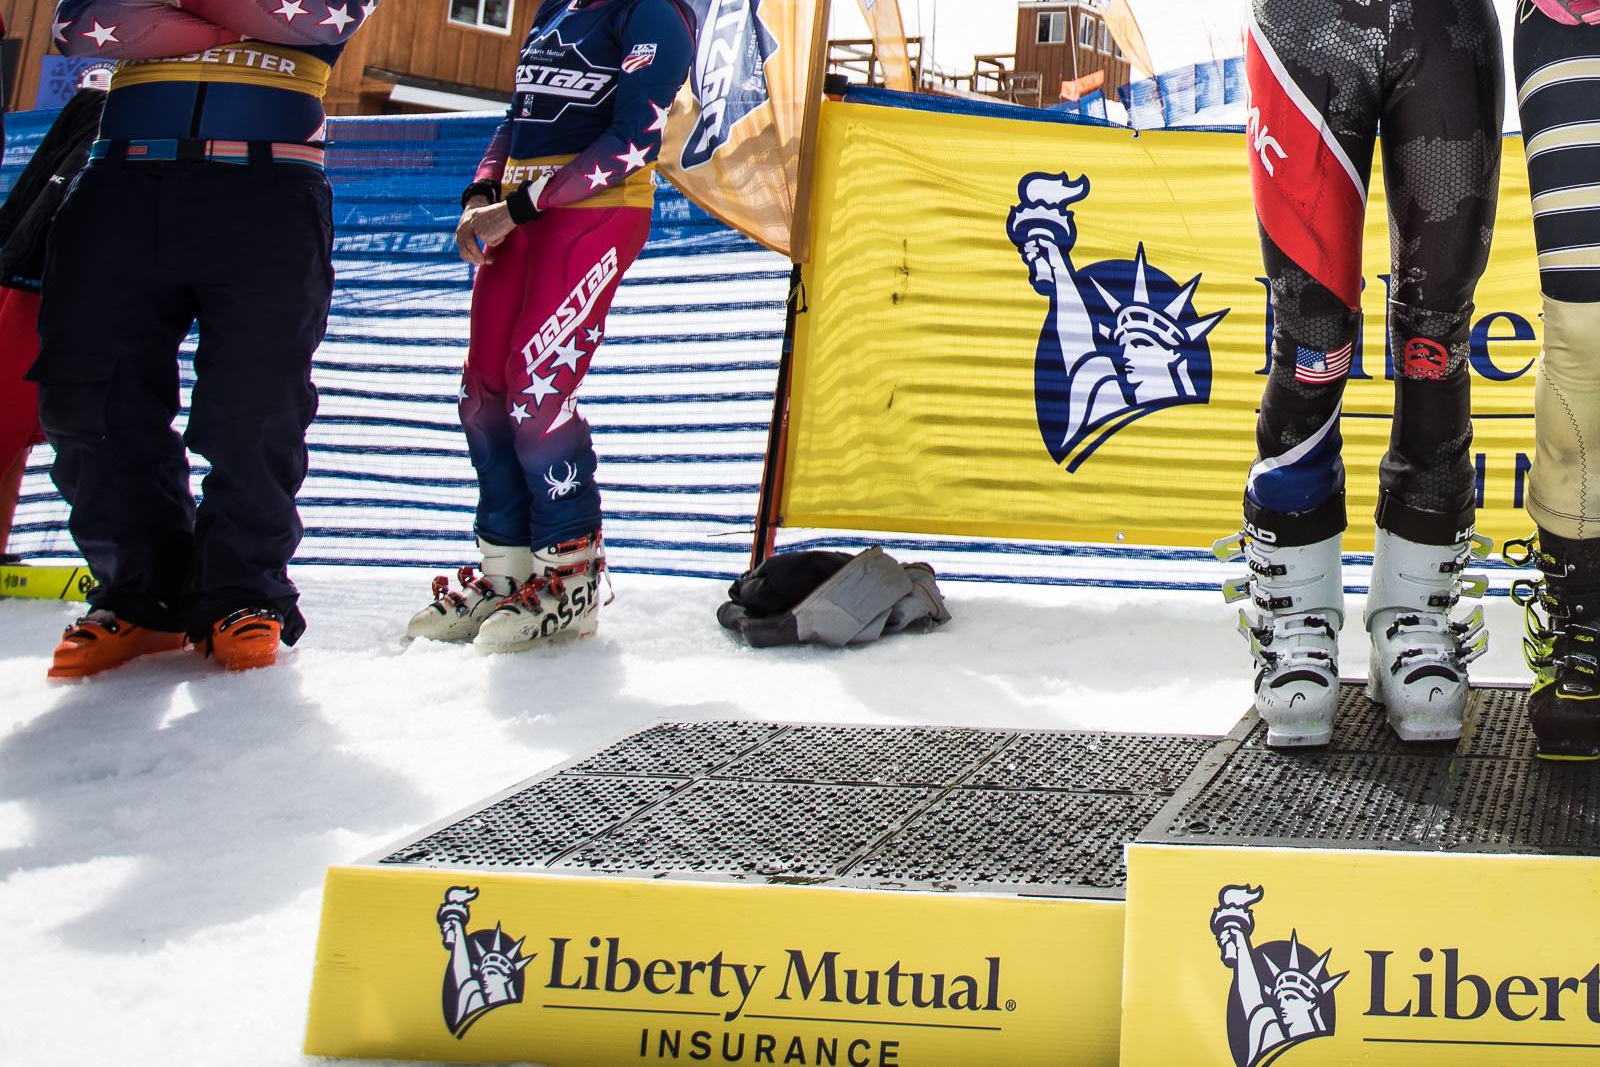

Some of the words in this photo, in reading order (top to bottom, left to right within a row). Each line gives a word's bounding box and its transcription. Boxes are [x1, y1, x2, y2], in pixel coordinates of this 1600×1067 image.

[1242, 519, 1277, 543] EAD
[1455, 524, 1476, 542] HE
[543, 936, 766, 1022] Liberty
[774, 948, 1004, 1012] Mutual
[640, 1027, 901, 1067] INSURANCE
